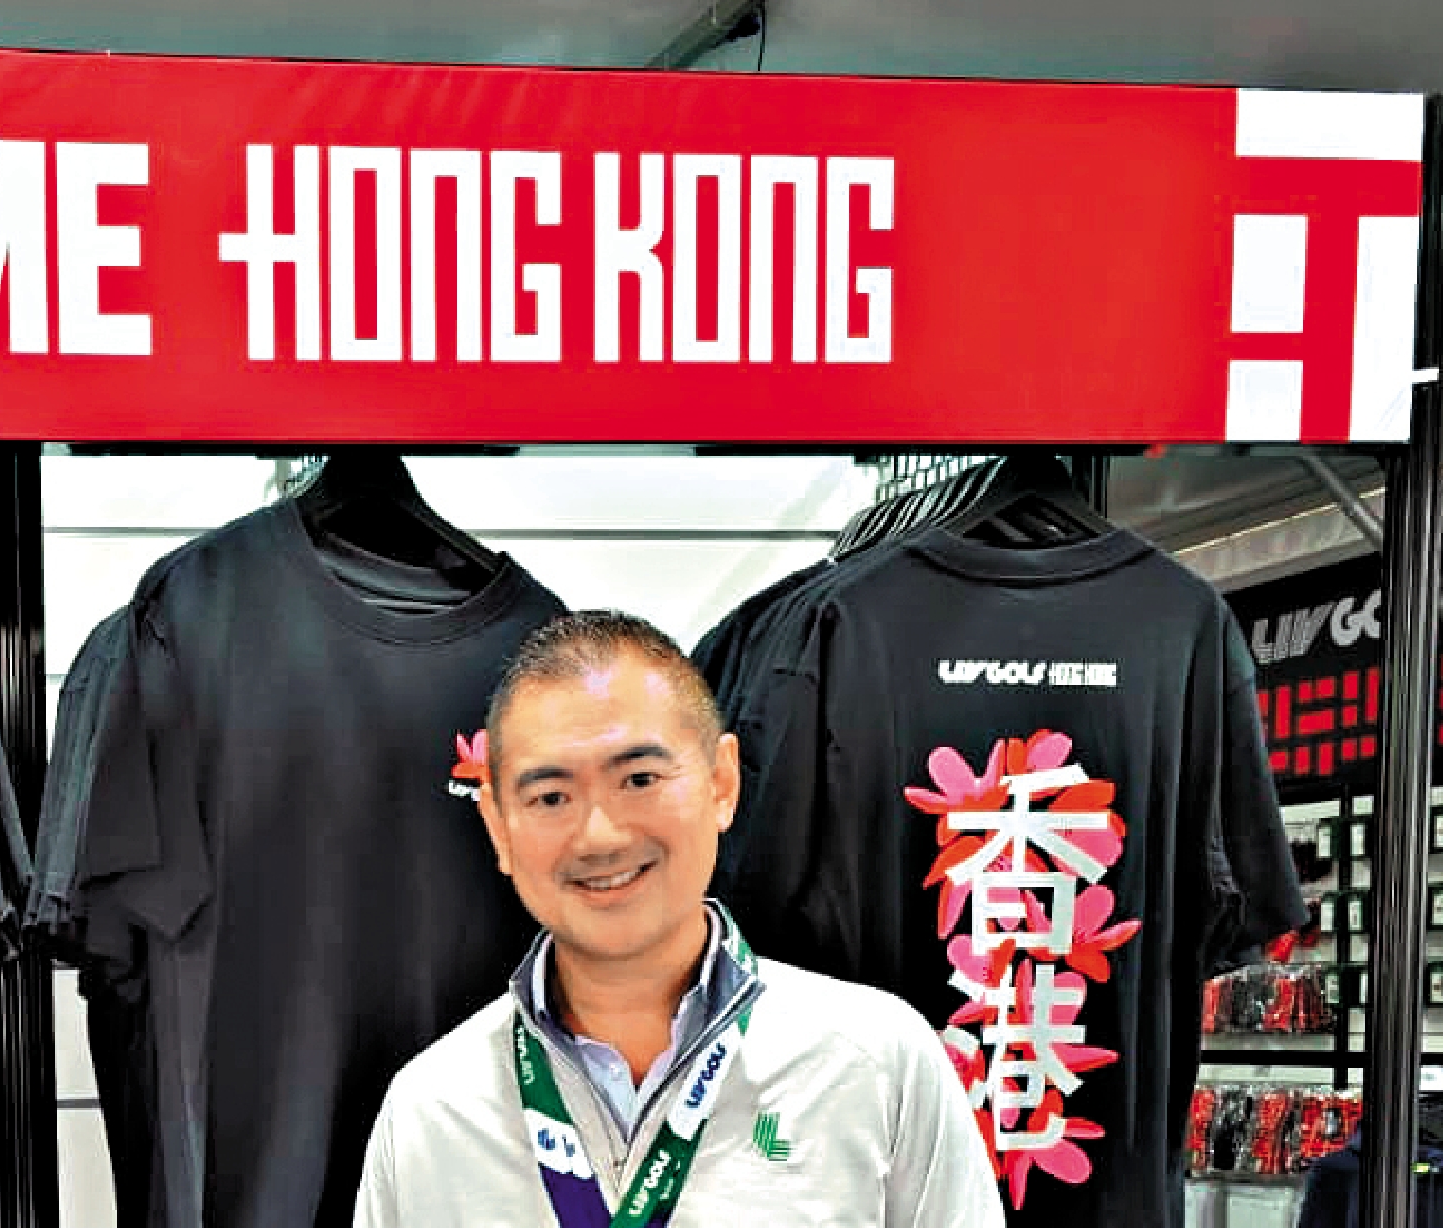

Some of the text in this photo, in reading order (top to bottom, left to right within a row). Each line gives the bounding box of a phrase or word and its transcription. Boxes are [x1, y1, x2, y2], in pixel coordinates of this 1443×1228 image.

[217, 143, 562, 362] HONG
[593, 151, 895, 363] KONG
[944, 763, 1108, 1151] 香港
